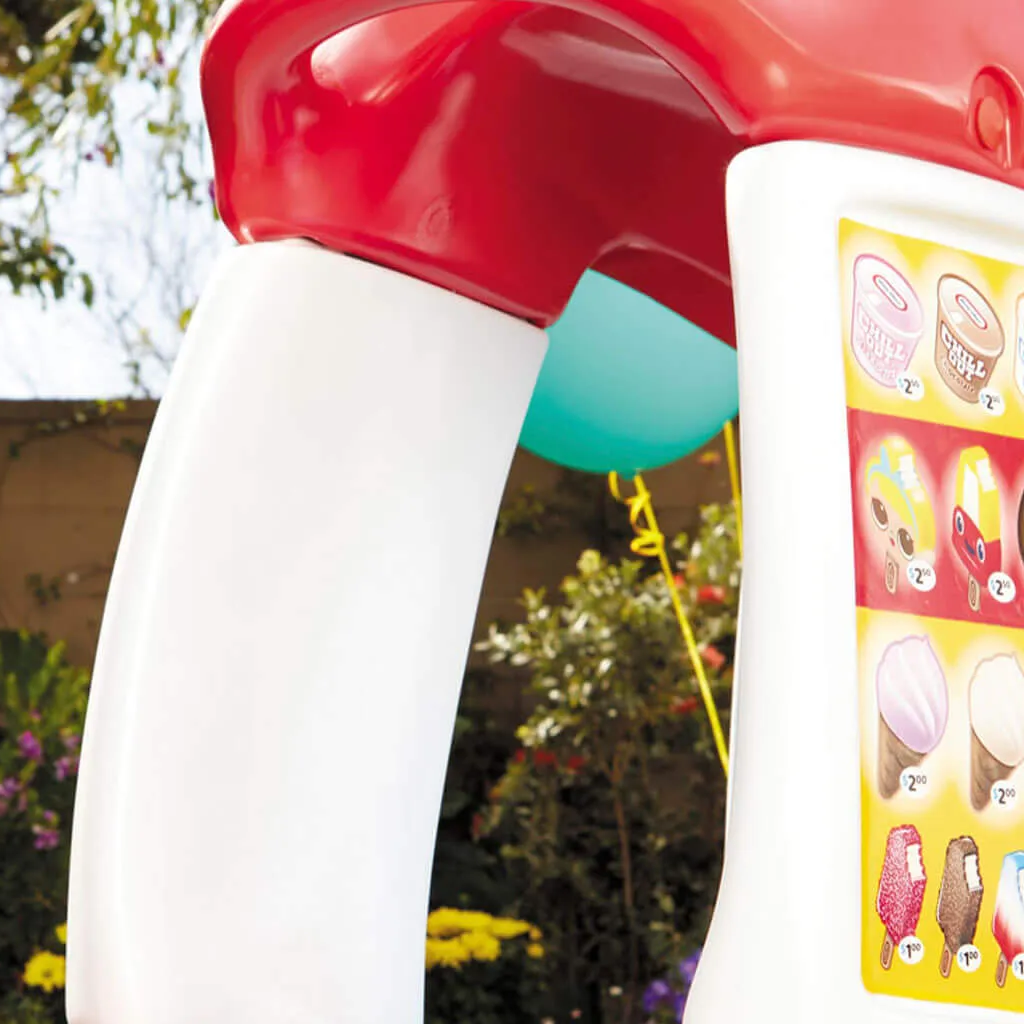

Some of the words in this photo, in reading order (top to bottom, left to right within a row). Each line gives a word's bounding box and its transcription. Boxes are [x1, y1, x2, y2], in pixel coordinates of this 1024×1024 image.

[857, 304, 907, 362] CHILL
[940, 322, 987, 379] CHILL
[948, 349, 973, 381] OUT
